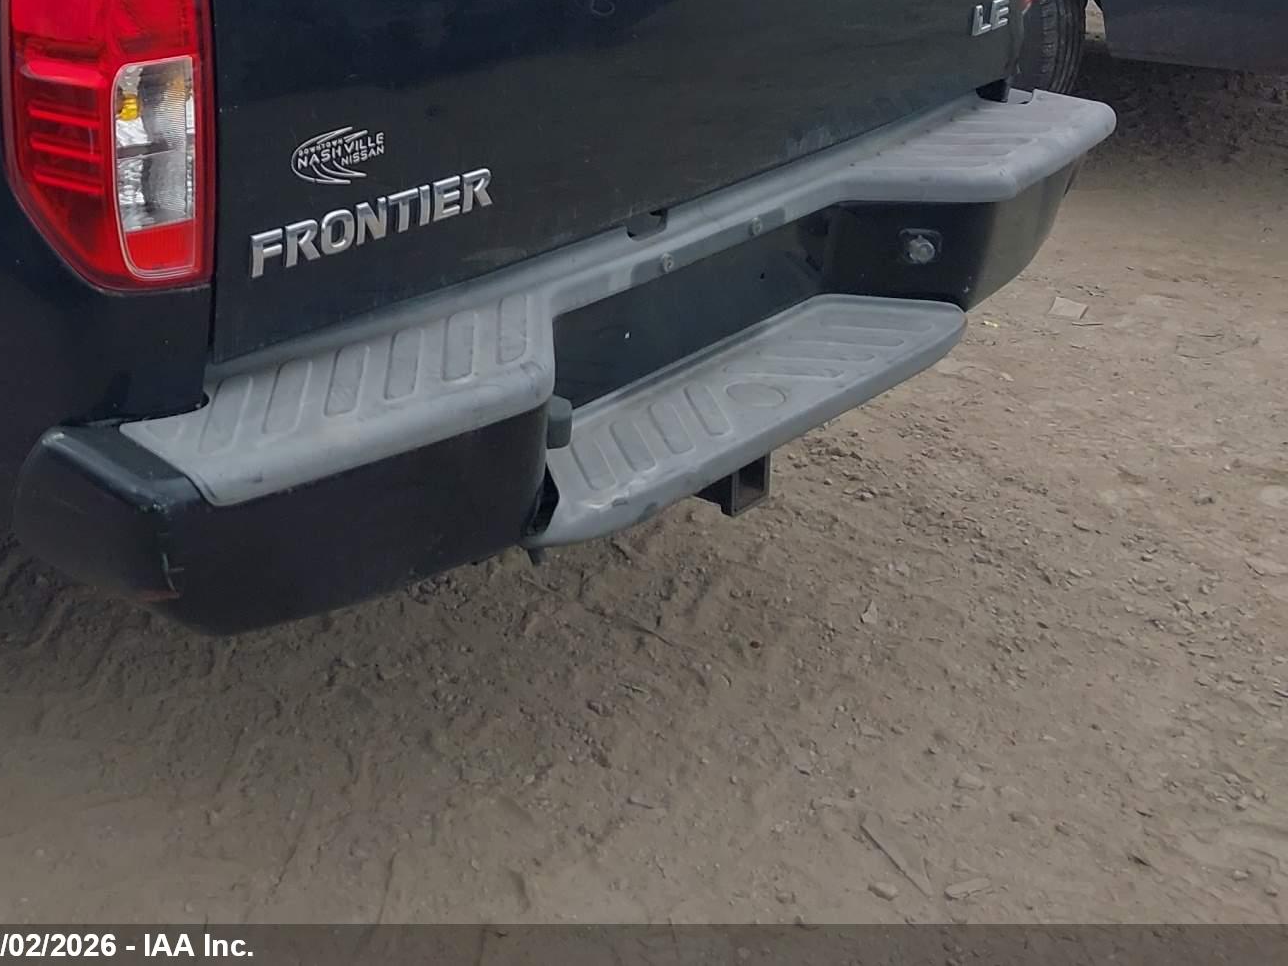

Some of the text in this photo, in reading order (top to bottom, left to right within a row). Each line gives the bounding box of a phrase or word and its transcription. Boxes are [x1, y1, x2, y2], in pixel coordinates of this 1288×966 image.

[297, 132, 385, 170] NASHVILLE
[298, 137, 344, 157] DOWNTOWN
[342, 145, 385, 166] NISSAN
[249, 167, 494, 279] FRONTIER
